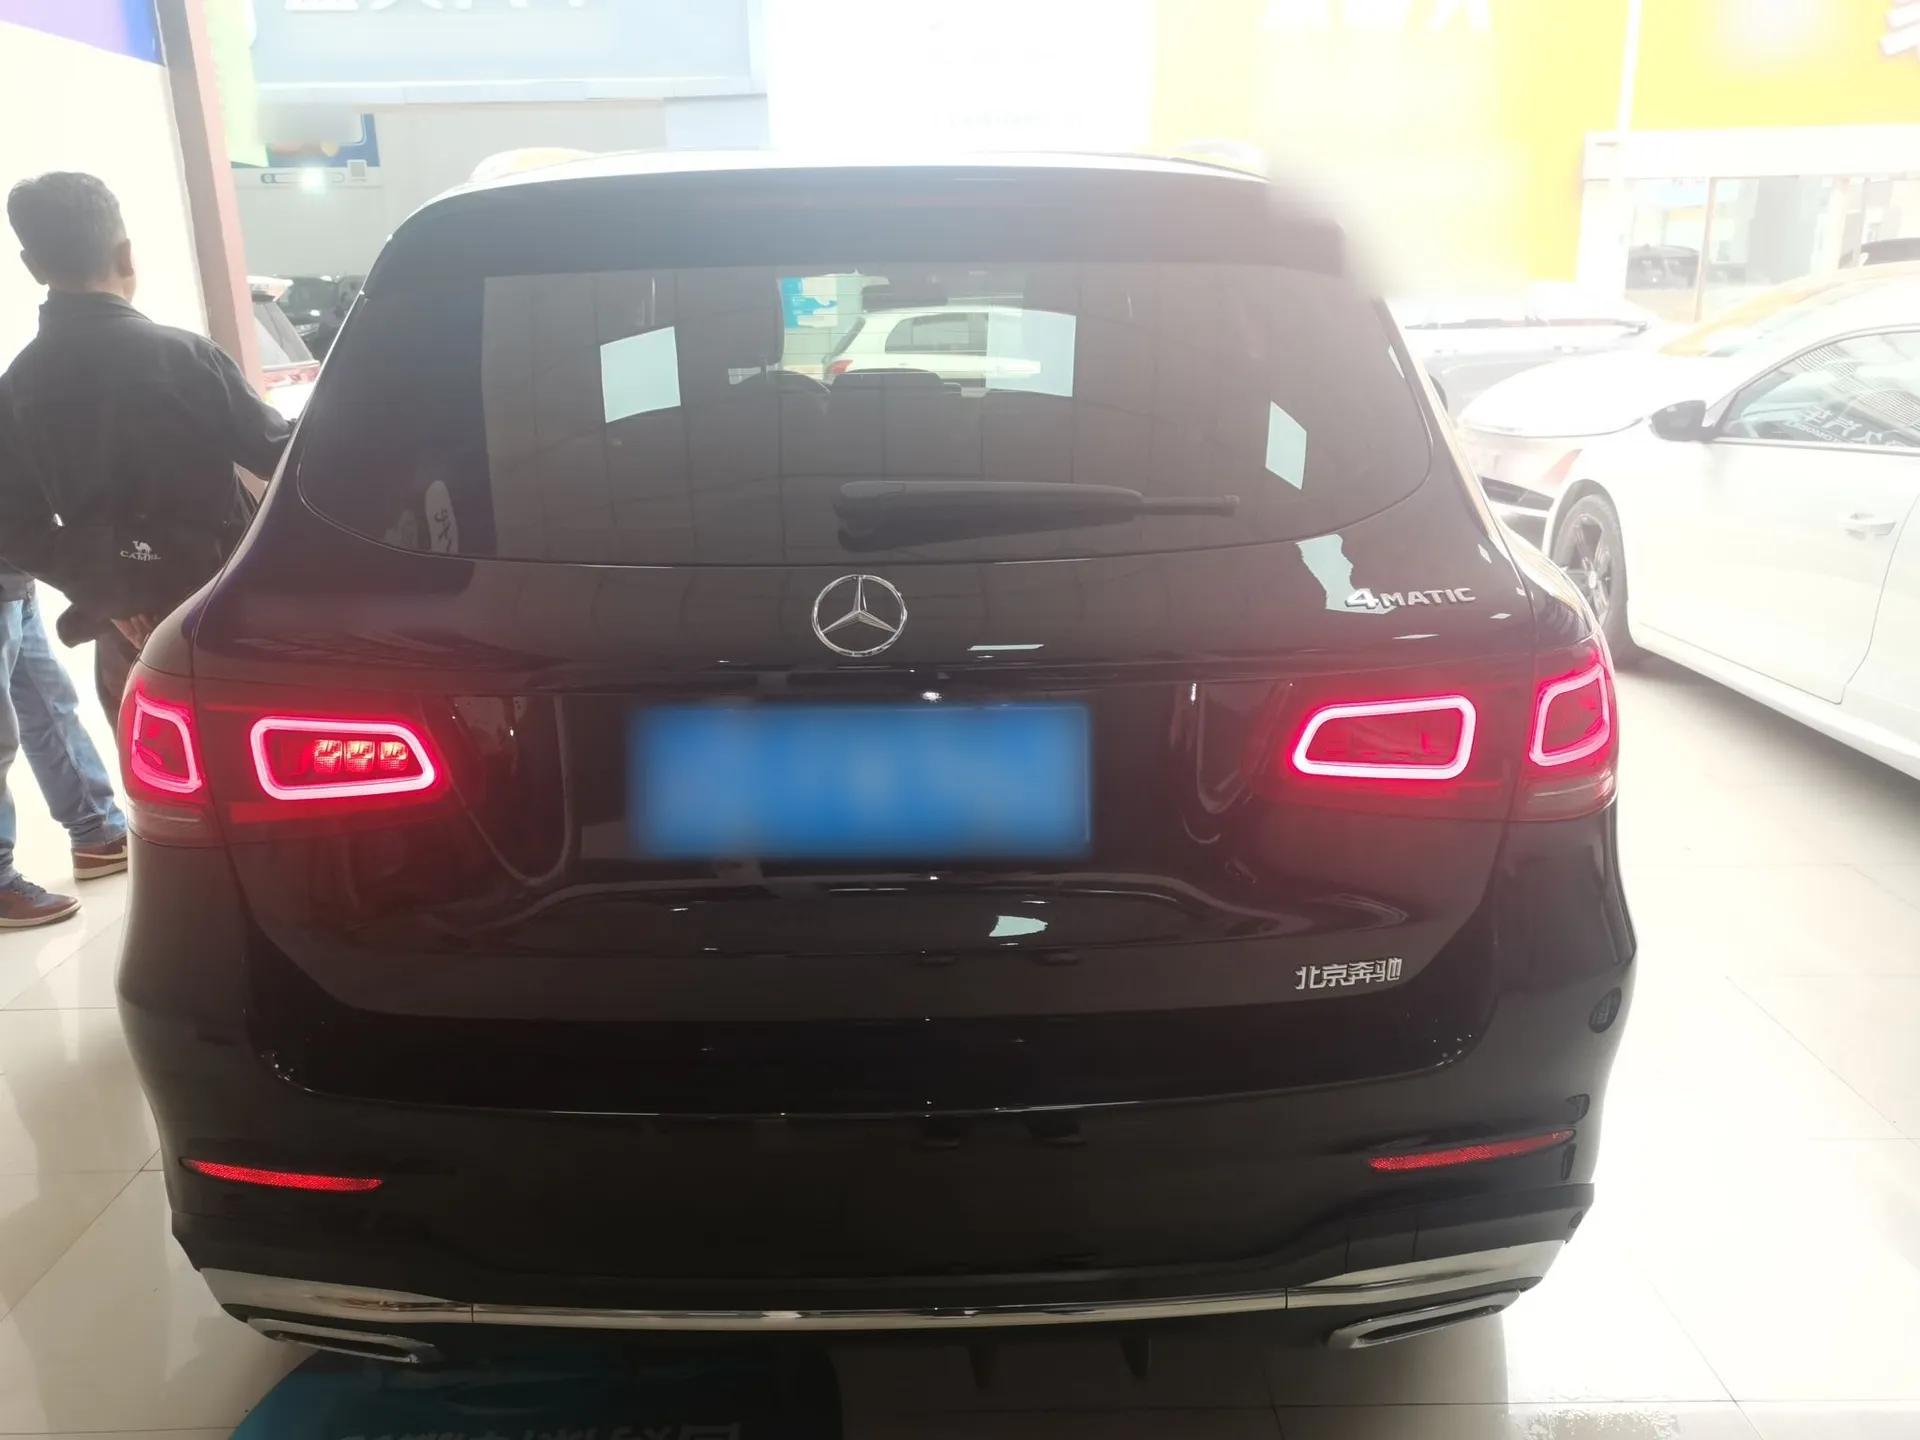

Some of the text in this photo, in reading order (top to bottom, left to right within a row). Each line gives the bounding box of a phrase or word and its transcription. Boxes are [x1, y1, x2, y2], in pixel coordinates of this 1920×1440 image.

[1345, 588, 1476, 609] 4MATIC
[1295, 958, 1402, 989] 北京奔驰
